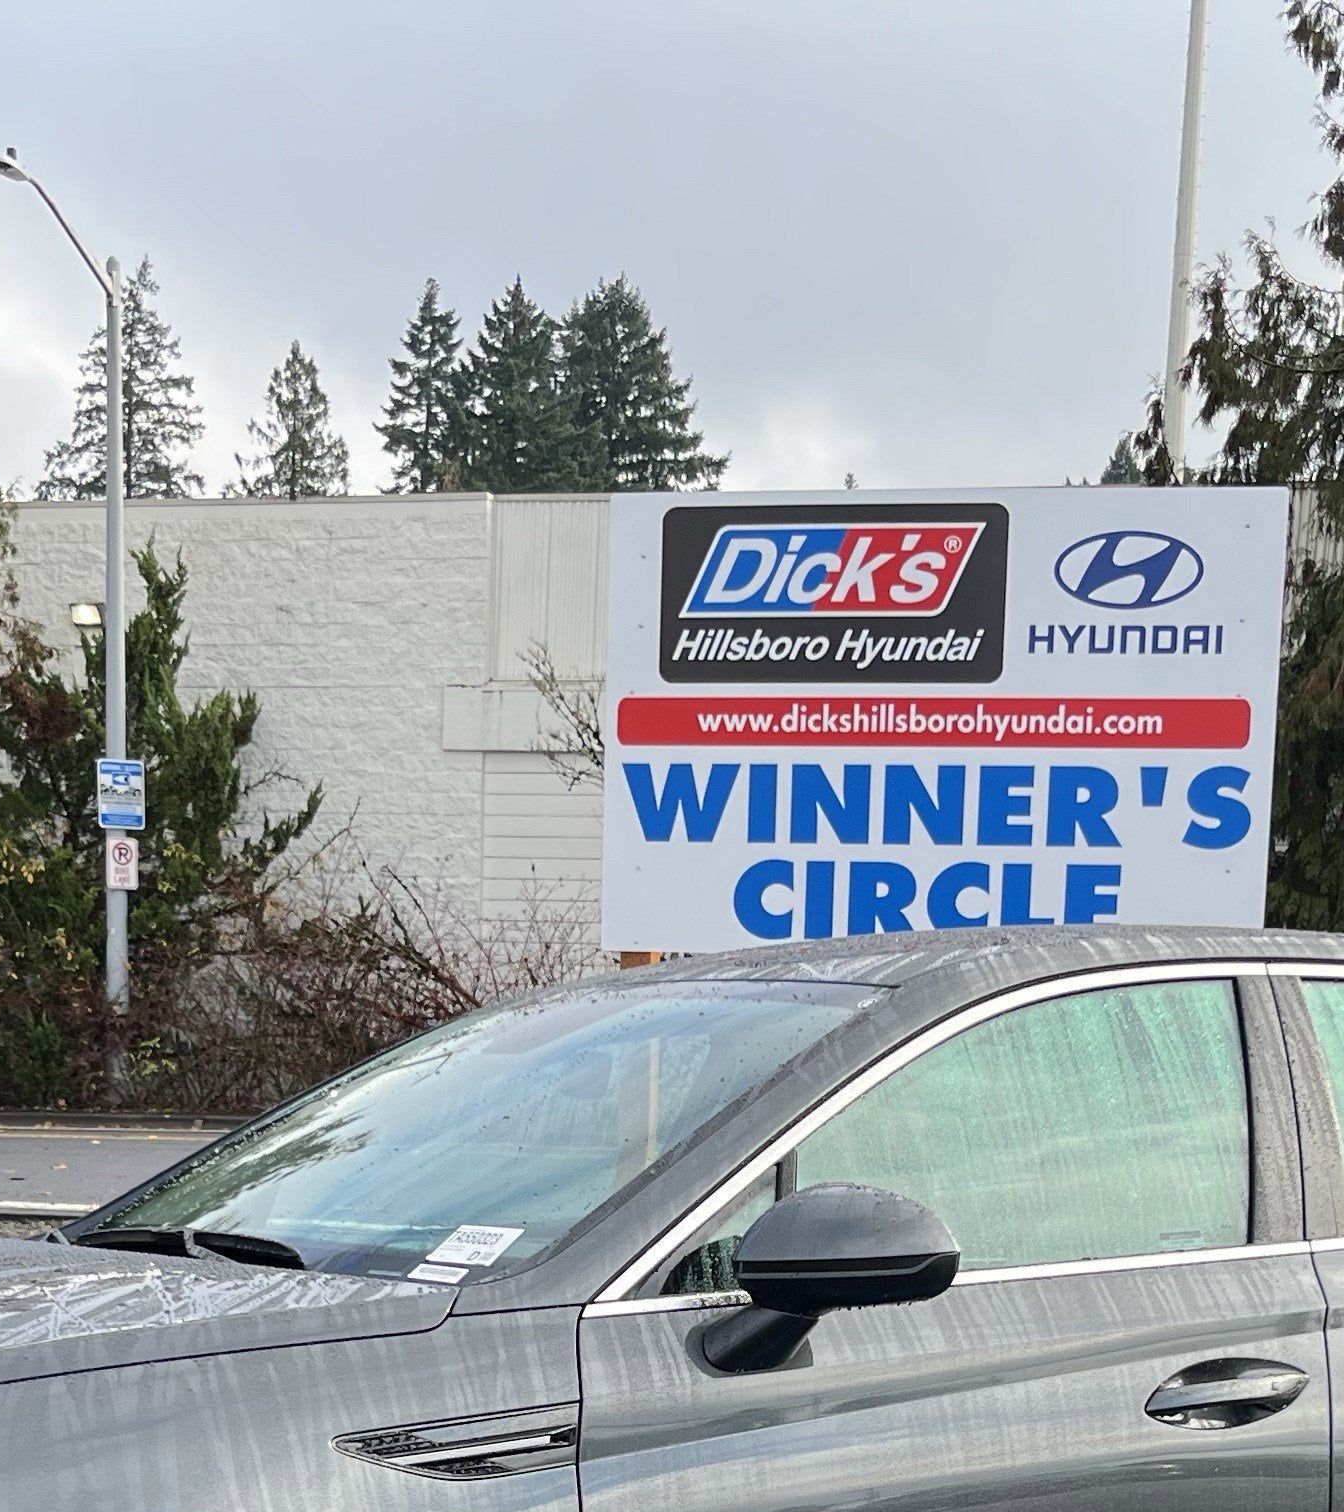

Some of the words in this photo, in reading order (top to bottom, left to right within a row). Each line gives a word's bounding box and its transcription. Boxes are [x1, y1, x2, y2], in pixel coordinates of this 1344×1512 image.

[672, 629, 830, 663] Hillsboro
[835, 630, 985, 670] Hyundai
[1029, 625, 1223, 655] HYUNDAI
[697, 703, 1163, 742] www.dickshillsborohyundai.com
[622, 763, 1252, 848] WINNER'S
